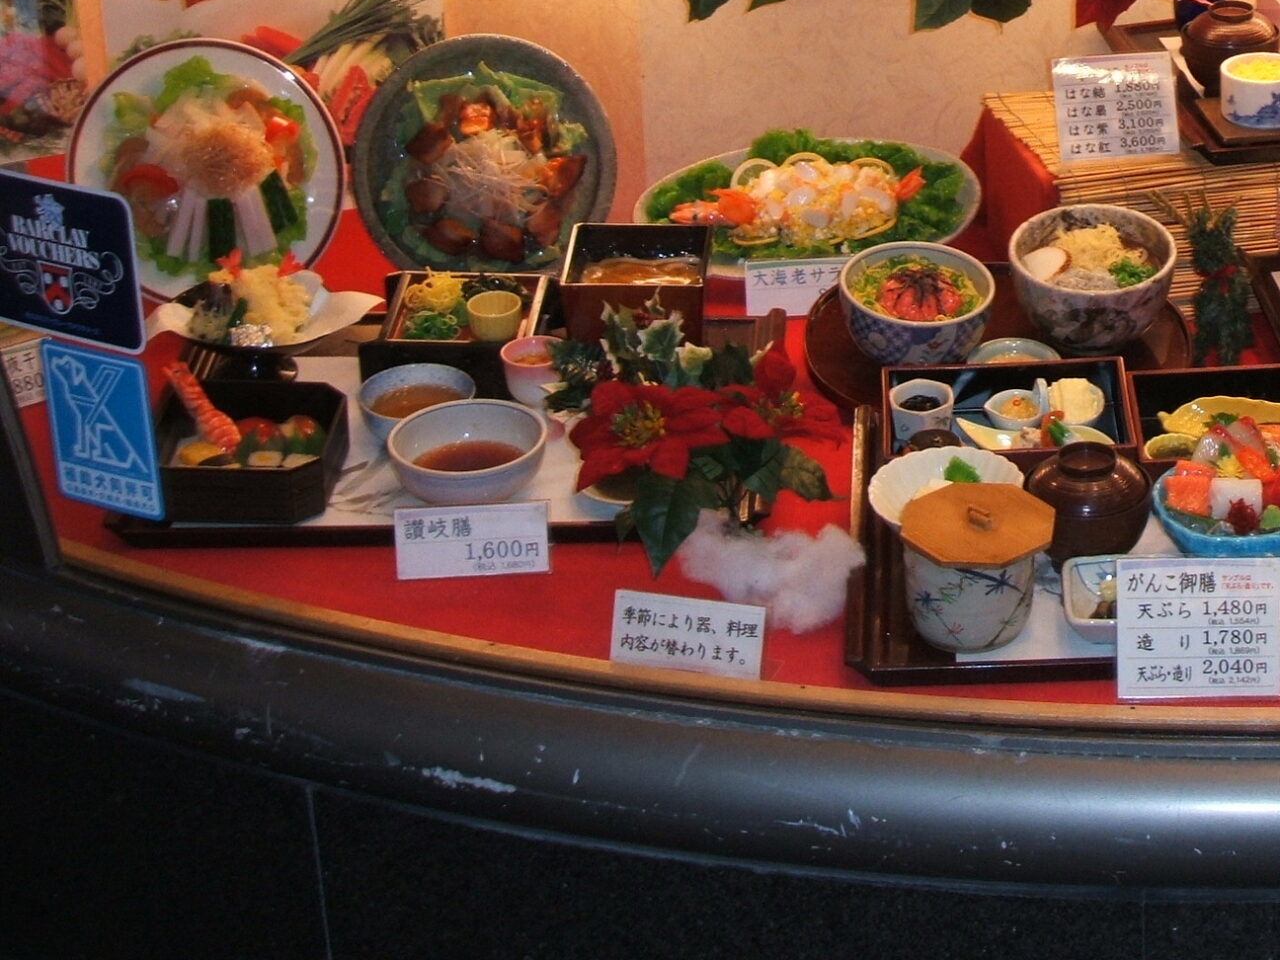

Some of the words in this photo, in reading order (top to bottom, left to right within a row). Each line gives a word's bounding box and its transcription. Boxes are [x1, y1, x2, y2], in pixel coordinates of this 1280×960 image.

[1115, 99, 1163, 112] 2,500円
[1117, 117, 1165, 131] 3,100円
[1119, 135, 1167, 149] 3,600円
[7, 232, 100, 271] VOUCHERS
[465, 539, 540, 562] 1,600円
[1127, 571, 1217, 595] がんこ御膳
[1202, 599, 1267, 617] 1,480円
[622, 605, 760, 639] 季節により器、料理
[1202, 629, 1268, 646] 1,780円
[620, 633, 746, 666] 内容が替わります。
[1202, 659, 1268, 676] 2,040円
